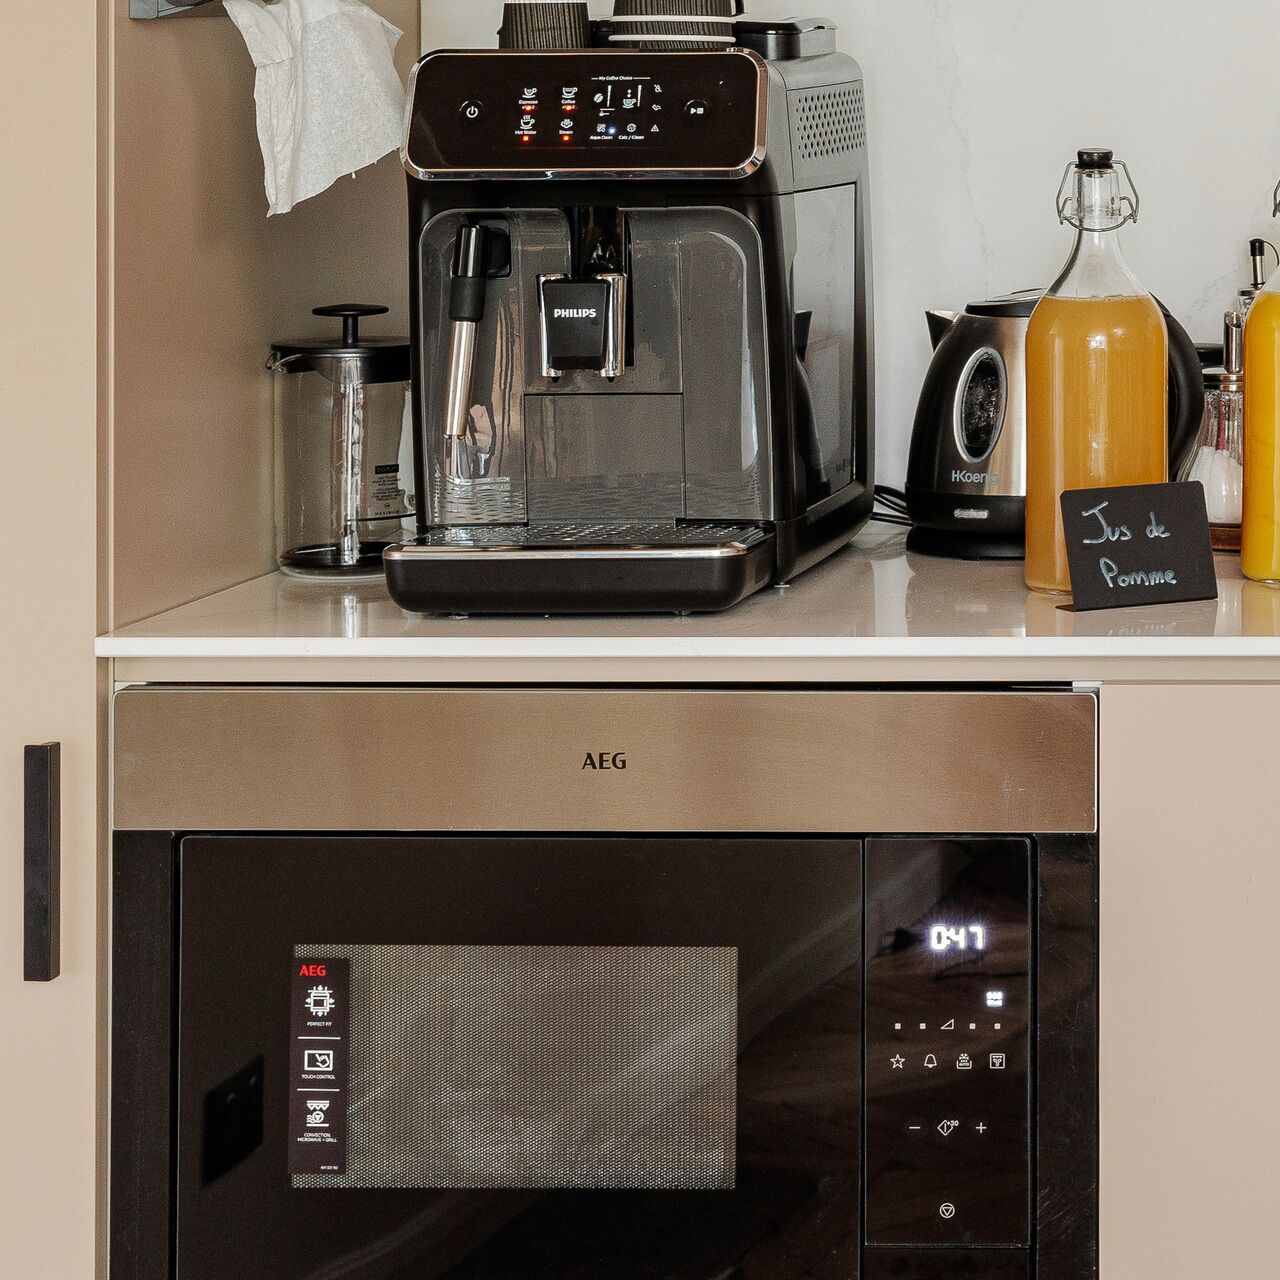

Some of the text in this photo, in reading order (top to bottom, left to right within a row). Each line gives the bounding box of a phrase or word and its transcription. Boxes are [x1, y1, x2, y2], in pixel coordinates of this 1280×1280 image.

[553, 308, 597, 318] PHILIPS
[1082, 501, 1171, 544] Jus de
[1100, 557, 1177, 588] Pomme
[581, 752, 627, 770] AEG
[299, 965, 326, 976] AEG
